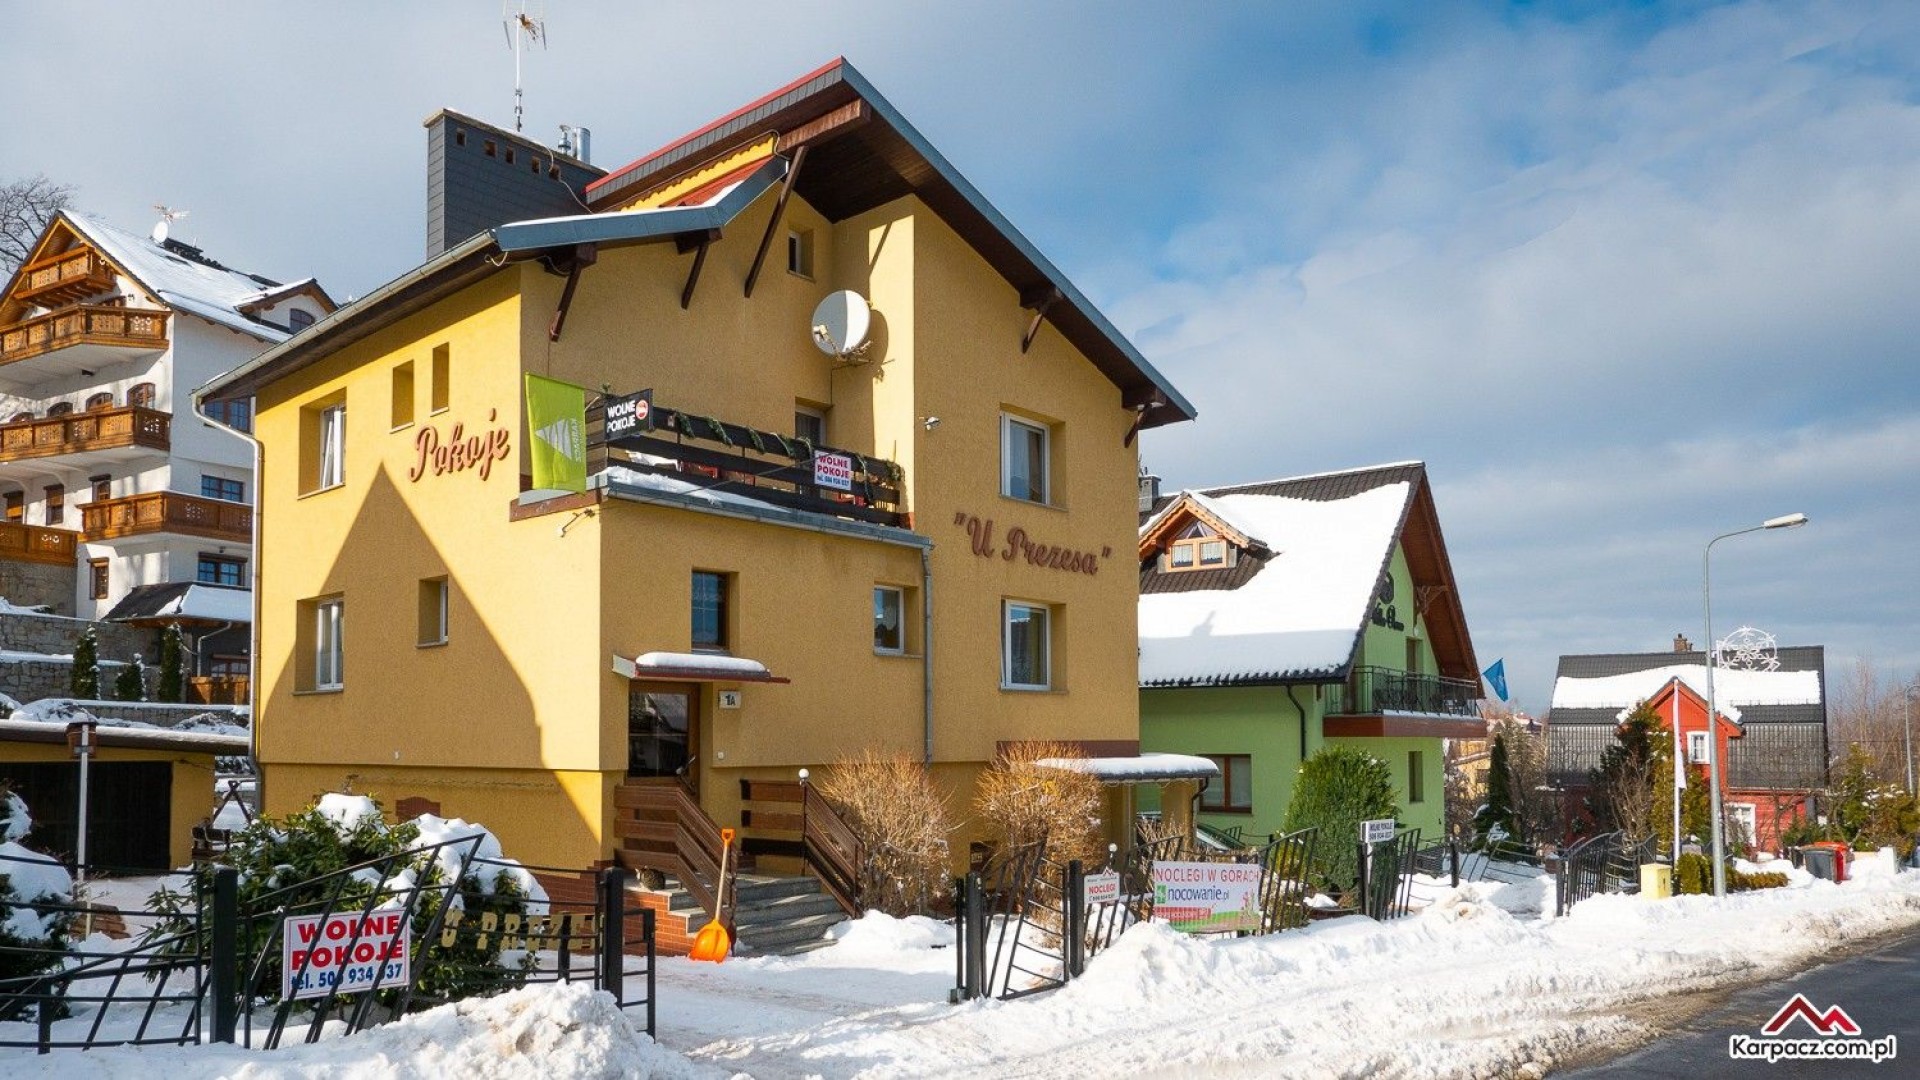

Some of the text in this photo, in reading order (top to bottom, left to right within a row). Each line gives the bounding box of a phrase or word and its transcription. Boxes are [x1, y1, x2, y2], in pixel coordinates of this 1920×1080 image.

[607, 400, 636, 418] WOLNE
[606, 415, 636, 433] POKOJE
[408, 407, 510, 483] Pokoje
[820, 456, 848, 468] WOLNE
[817, 465, 850, 478] POKOJE
[1001, 526, 1112, 576] Prezesa"
[725, 694, 736, 705] 1A
[1156, 868, 1204, 882] NOCLEGI
[1207, 869, 1217, 881] W
[1088, 883, 1116, 895] NOCLEGI
[1168, 885, 1230, 902] nocowanie.pl
[297, 915, 401, 944] WOLNE
[291, 939, 403, 971] POKOJE
[348, 966, 374, 984] 934
